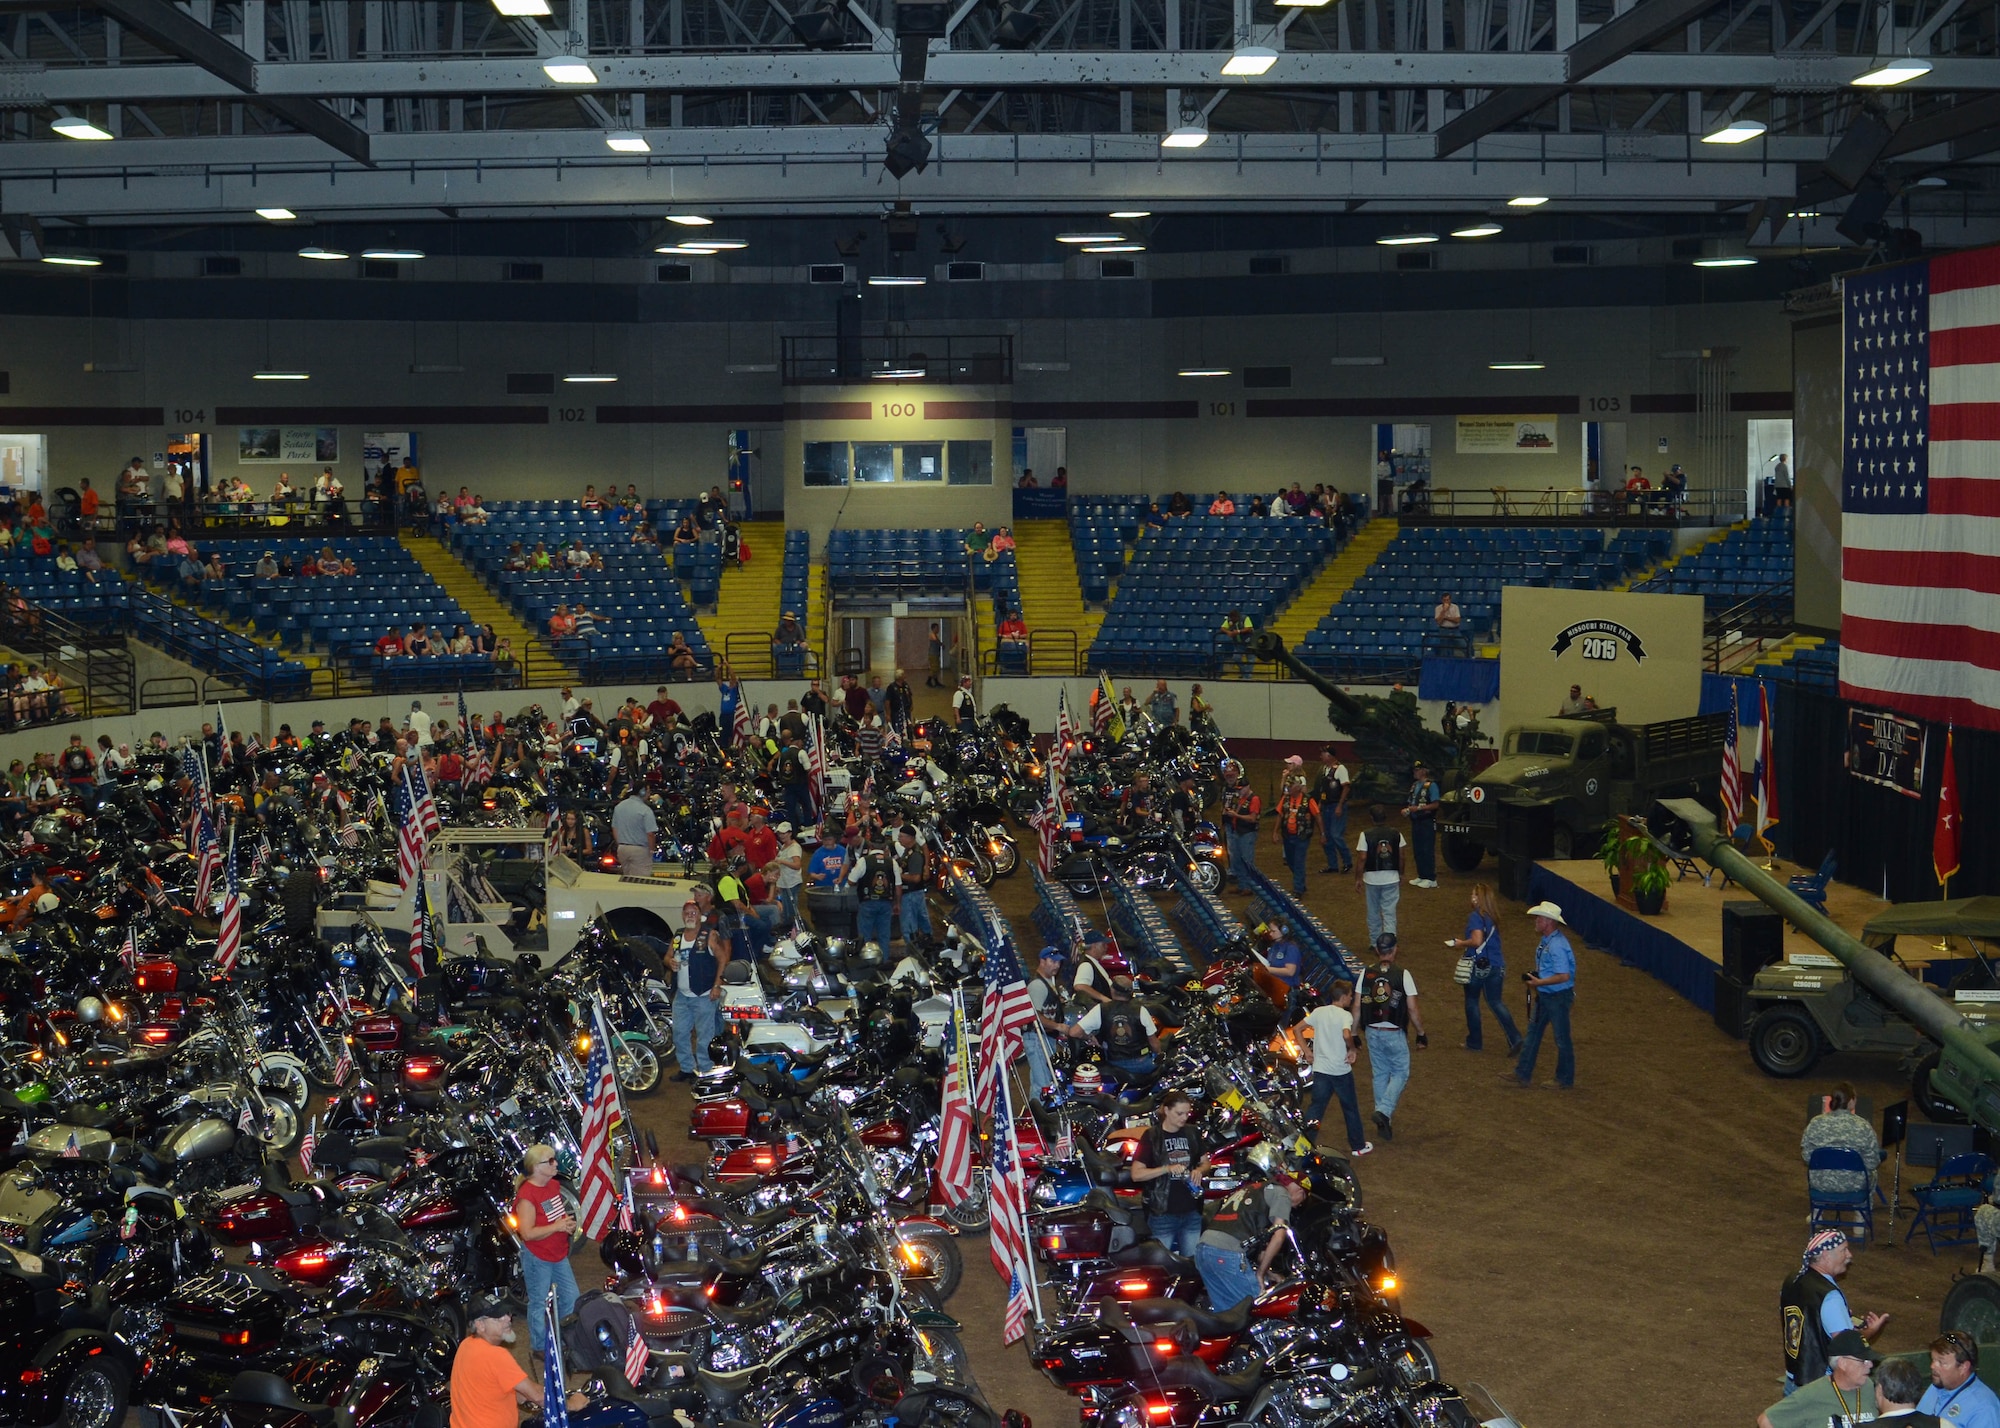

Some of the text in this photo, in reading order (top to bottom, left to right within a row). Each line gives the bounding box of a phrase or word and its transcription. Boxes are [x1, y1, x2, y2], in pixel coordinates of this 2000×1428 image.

[882, 403, 916, 418] 100
[1209, 402, 1235, 416] 101
[1589, 397, 1621, 412] 103
[174, 409, 206, 424] 104
[558, 407, 585, 422] 102
[286, 430, 312, 440] Enjoy
[282, 440, 315, 450] Sedalia
[286, 451, 313, 460] Parks
[1567, 622, 1634, 642] MISSOURI STATE FAIR
[1583, 637, 1617, 660] 2015
